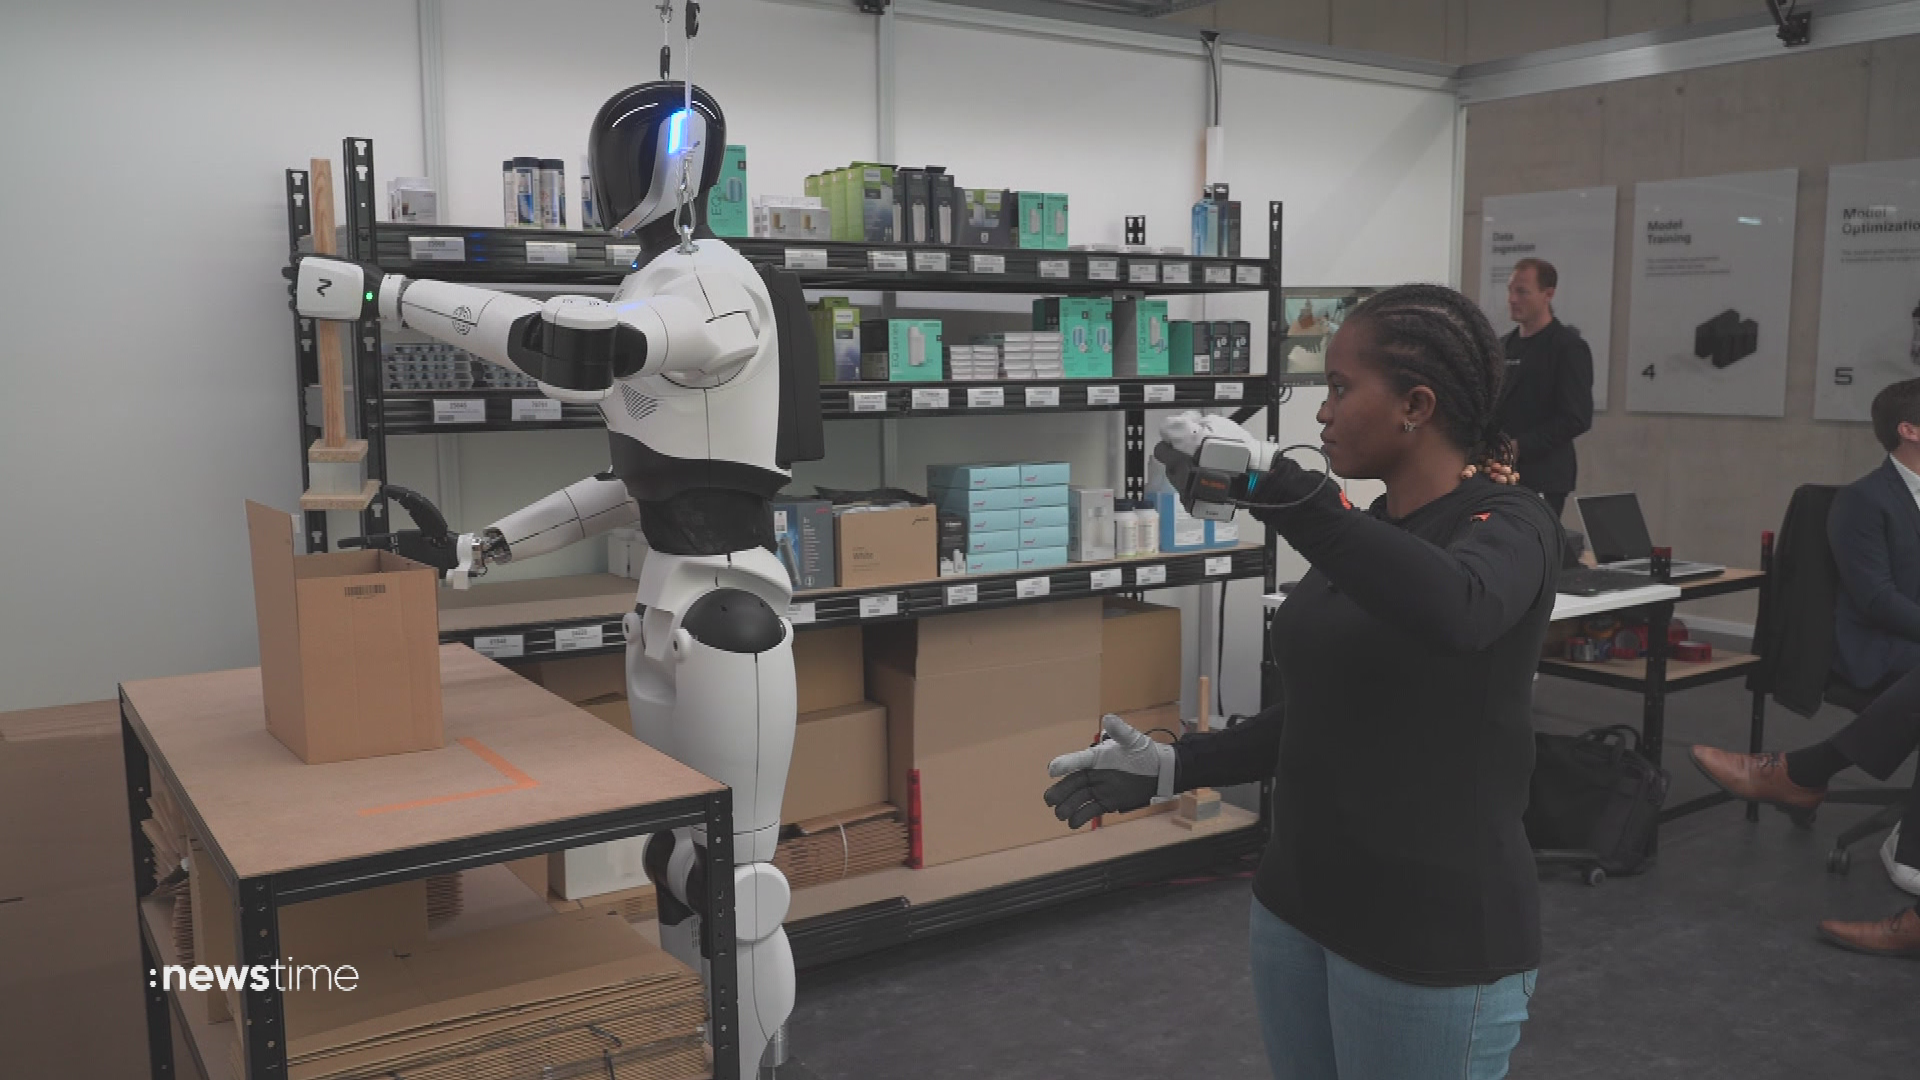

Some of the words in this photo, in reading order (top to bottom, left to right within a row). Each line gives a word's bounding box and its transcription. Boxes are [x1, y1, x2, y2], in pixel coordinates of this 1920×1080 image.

[1647, 219, 1682, 231] Model
[1492, 232, 1514, 242] Data
[1647, 233, 1692, 246] Training
[891, 353, 899, 368] EQ
[1641, 363, 1656, 381] 4
[1834, 366, 1854, 386] 5
